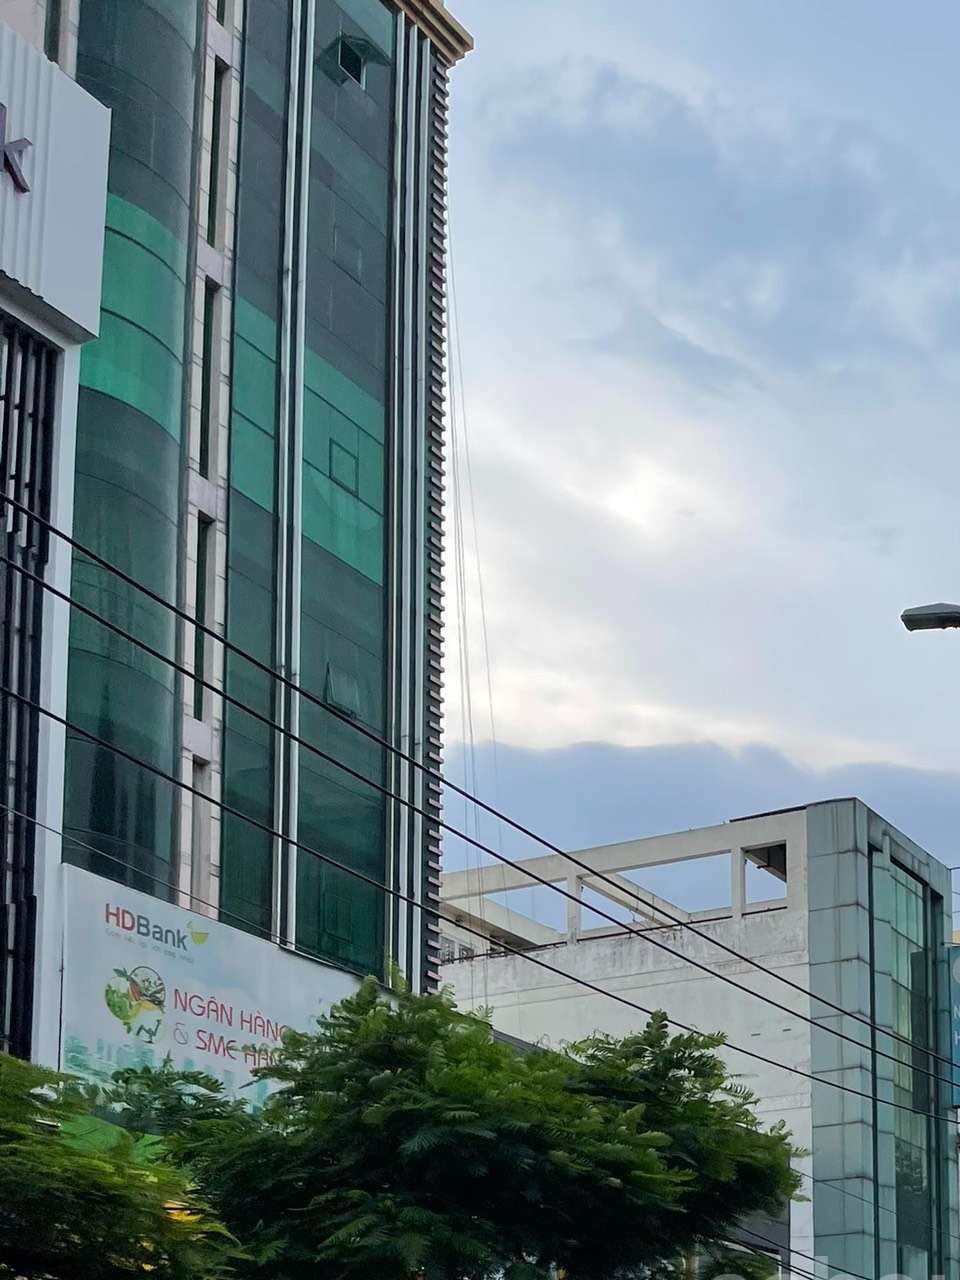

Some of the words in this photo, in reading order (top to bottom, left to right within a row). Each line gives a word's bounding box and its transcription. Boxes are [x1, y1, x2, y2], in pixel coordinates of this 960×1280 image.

[105, 902, 188, 951] HDBank
[174, 989, 233, 1027] NGÂN
[196, 1029, 236, 1060] SME
